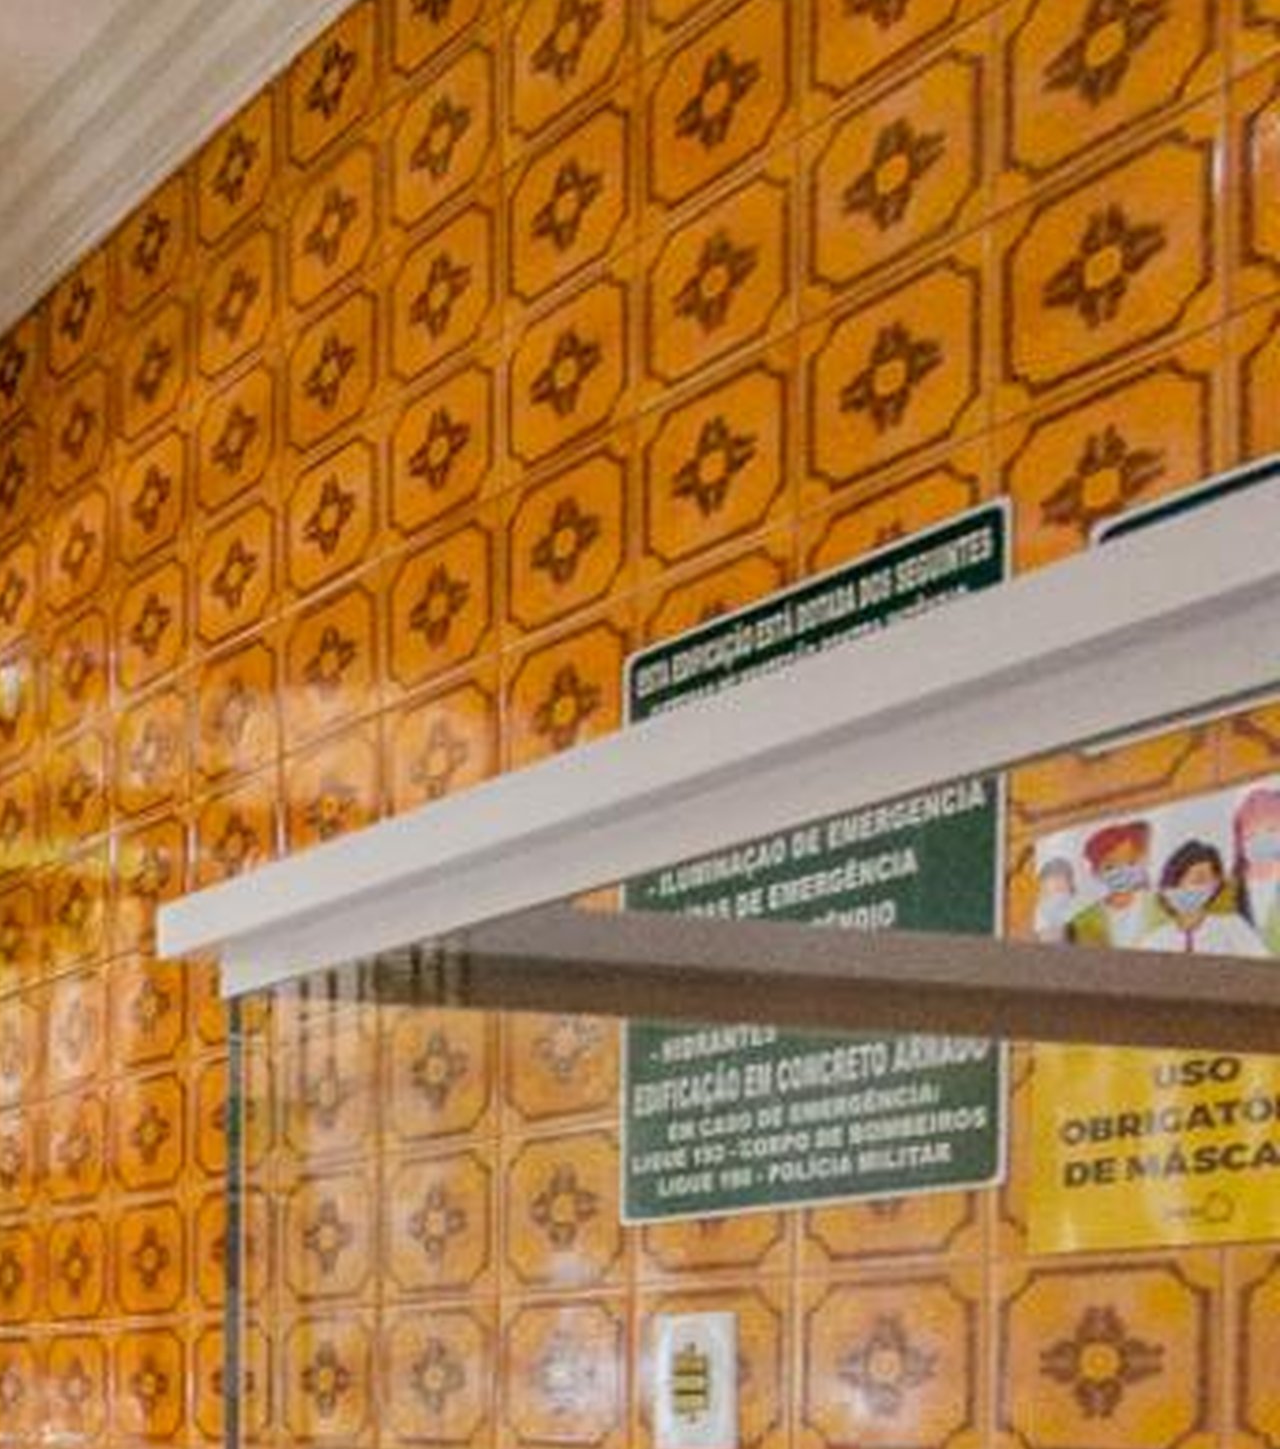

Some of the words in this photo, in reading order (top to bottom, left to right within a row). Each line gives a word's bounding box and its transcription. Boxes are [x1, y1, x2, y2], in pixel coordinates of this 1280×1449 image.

[791, 827, 820, 860] DE
[737, 888, 765, 918] DE
[768, 849, 918, 910] EMERGÊNCIA
[634, 1061, 740, 1117] EDIFICAÇÃO
[744, 1061, 773, 1098] EM
[777, 1041, 888, 1093] CONCRETO
[1155, 1056, 1243, 1088] USO
[668, 1120, 695, 1143] EM
[699, 1111, 752, 1137] CASO
[757, 1105, 784, 1129] DE
[740, 1131, 810, 1159] CORPO
[814, 1125, 843, 1148] DE
[848, 1105, 987, 1144] BOMBEIROS
[1061, 1089, 1280, 1146] OBRIGATÓ
[657, 1171, 714, 1197] LIGUE
[767, 1153, 853, 1185] POLÍCIA
[858, 1142, 952, 1173] MILITAR
[1064, 1156, 1116, 1189] DE
